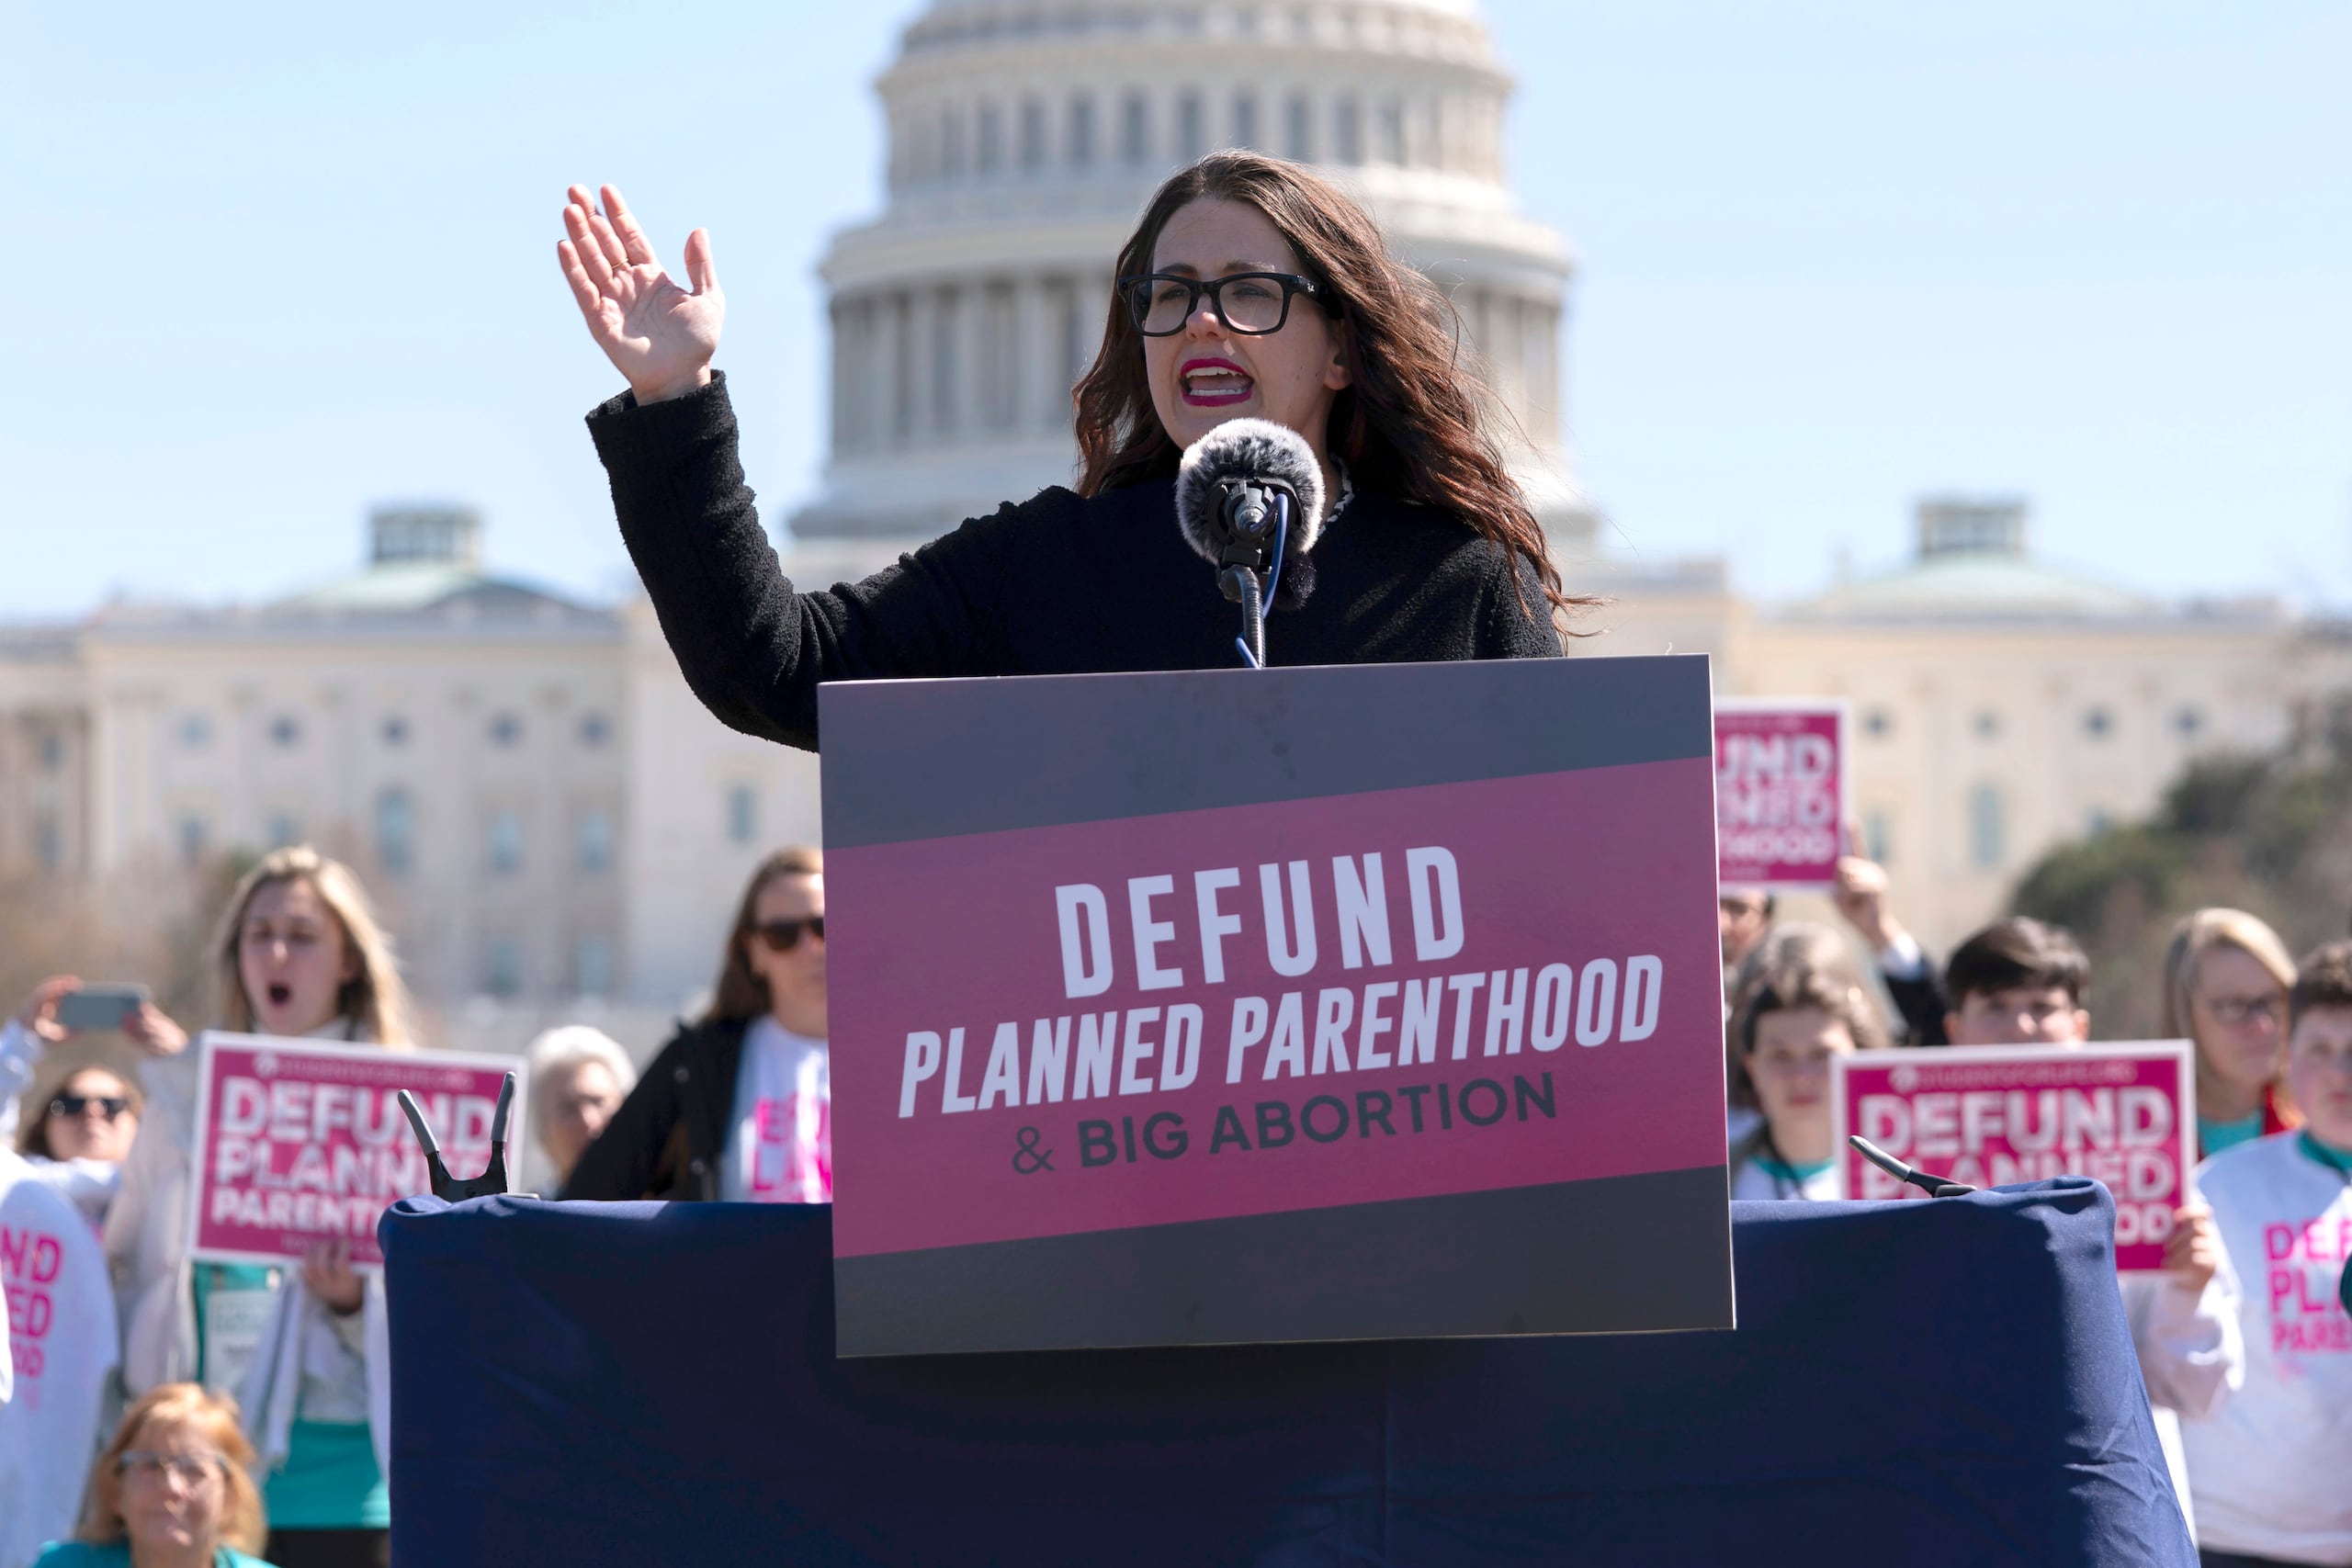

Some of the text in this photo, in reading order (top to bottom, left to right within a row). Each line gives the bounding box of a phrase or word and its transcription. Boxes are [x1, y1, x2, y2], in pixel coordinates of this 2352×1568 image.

[1719, 829, 1836, 863] HOOD
[1055, 846, 1465, 1000] DEFUND
[898, 954, 1664, 1120] PLANNED PARENTHOOD
[220, 1077, 497, 1149] DEFUND
[1012, 1072, 1558, 1175] & BIG ABORTION
[1859, 1086, 2174, 1156] DEFUND
[210, 1187, 380, 1237] PARENT
